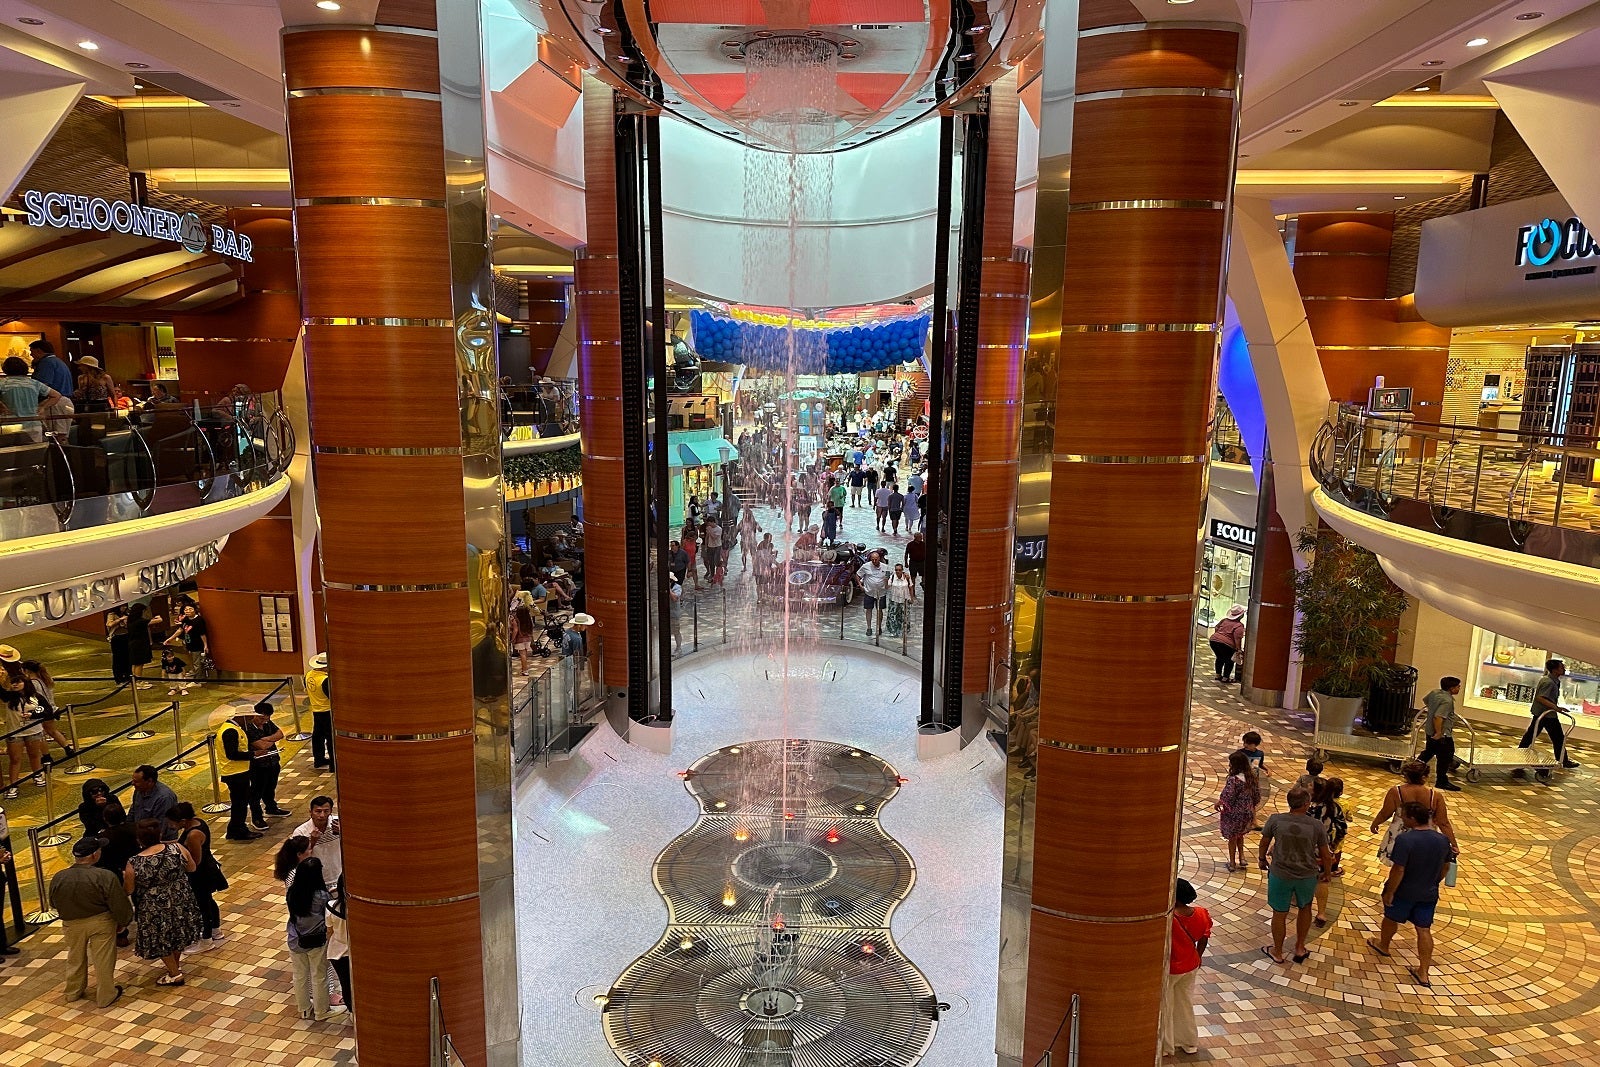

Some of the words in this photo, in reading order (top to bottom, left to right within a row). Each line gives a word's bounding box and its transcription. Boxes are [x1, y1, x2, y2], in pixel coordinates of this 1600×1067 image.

[24, 190, 182, 242] SCHOONER
[211, 224, 253, 262] BAR
[1514, 216, 1600, 267] FOCU
[8, 572, 126, 628] GUEST
[137, 539, 220, 594] SERVICES
